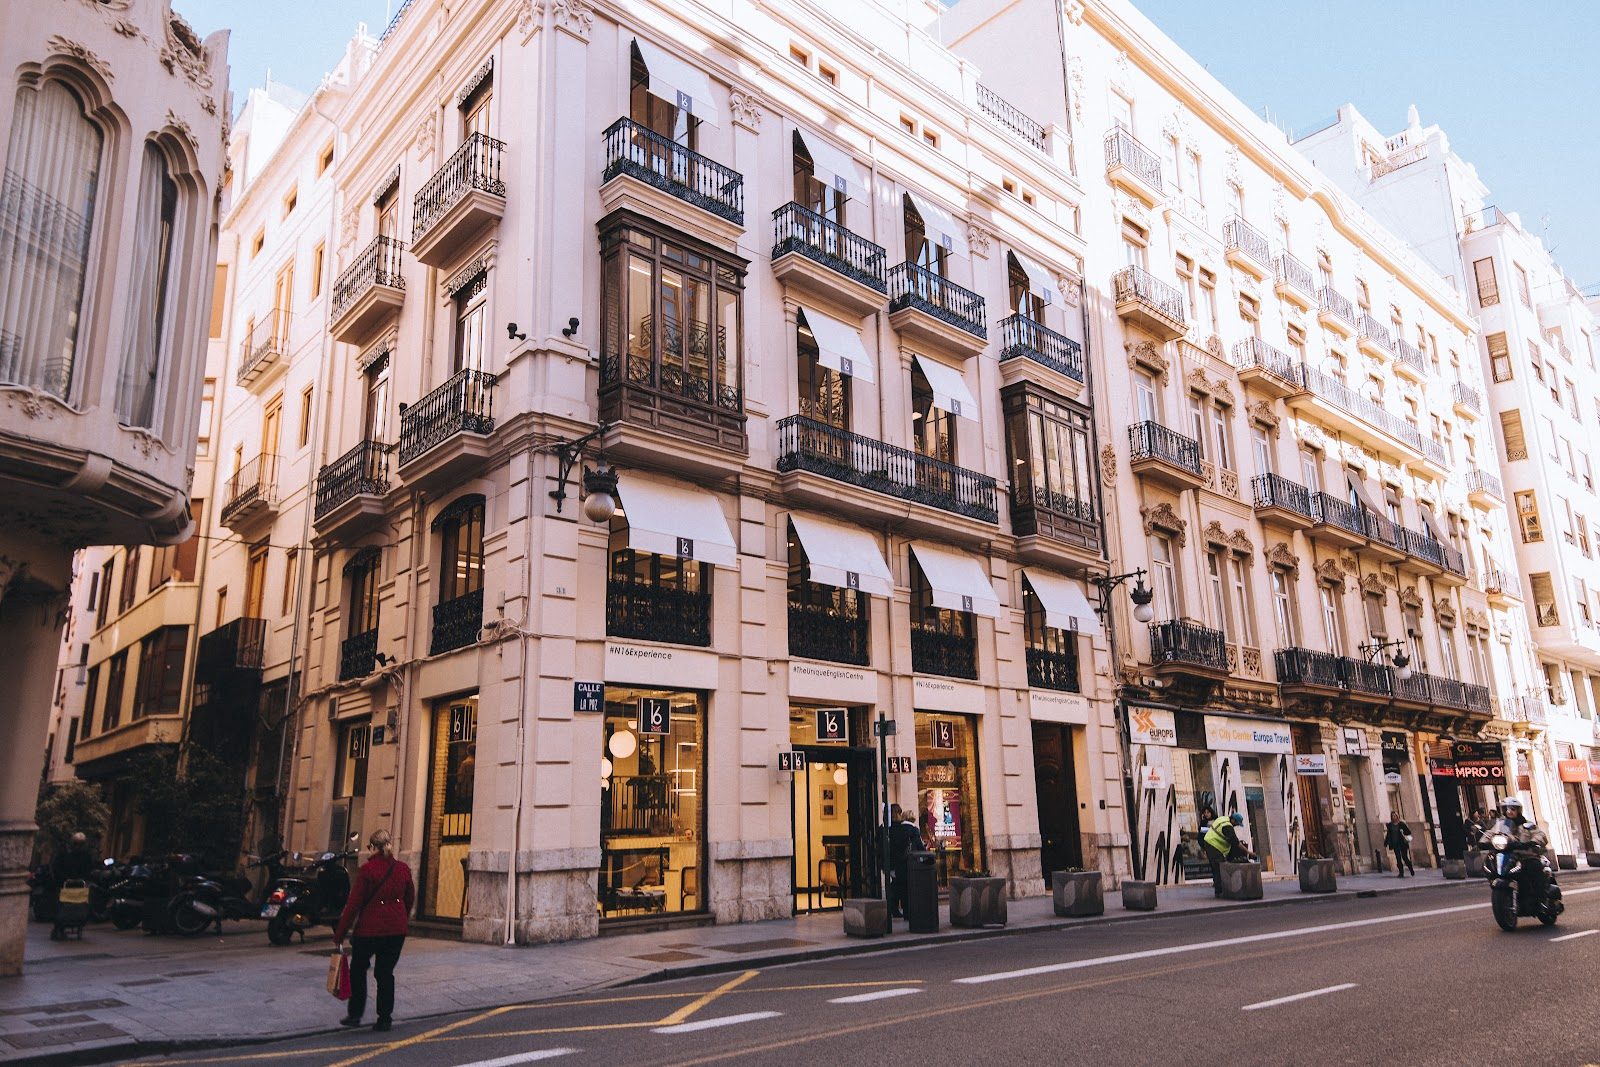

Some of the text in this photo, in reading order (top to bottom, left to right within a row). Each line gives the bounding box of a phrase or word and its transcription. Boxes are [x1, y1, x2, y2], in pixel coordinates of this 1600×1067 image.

[680, 93, 688, 107] 16
[838, 179, 844, 190] 16
[843, 358, 850, 371] 16
[681, 538, 689, 553] 16
[850, 572, 856, 586] 16
[609, 646, 672, 660] #N16Experience
[578, 683, 601, 692] CALLE
[580, 698, 587, 710] LA
[650, 699, 662, 725] 16
[453, 709, 460, 733] 16
[825, 711, 838, 732] 16
[940, 722, 949, 741] 16
[1218, 728, 1231, 741] City
[1253, 731, 1273, 744] Europa
[1274, 733, 1290, 744] Travel
[781, 753, 788, 767] 16
[795, 753, 801, 767] 16
[891, 758, 897, 769] 16
[903, 757, 909, 769] 16
